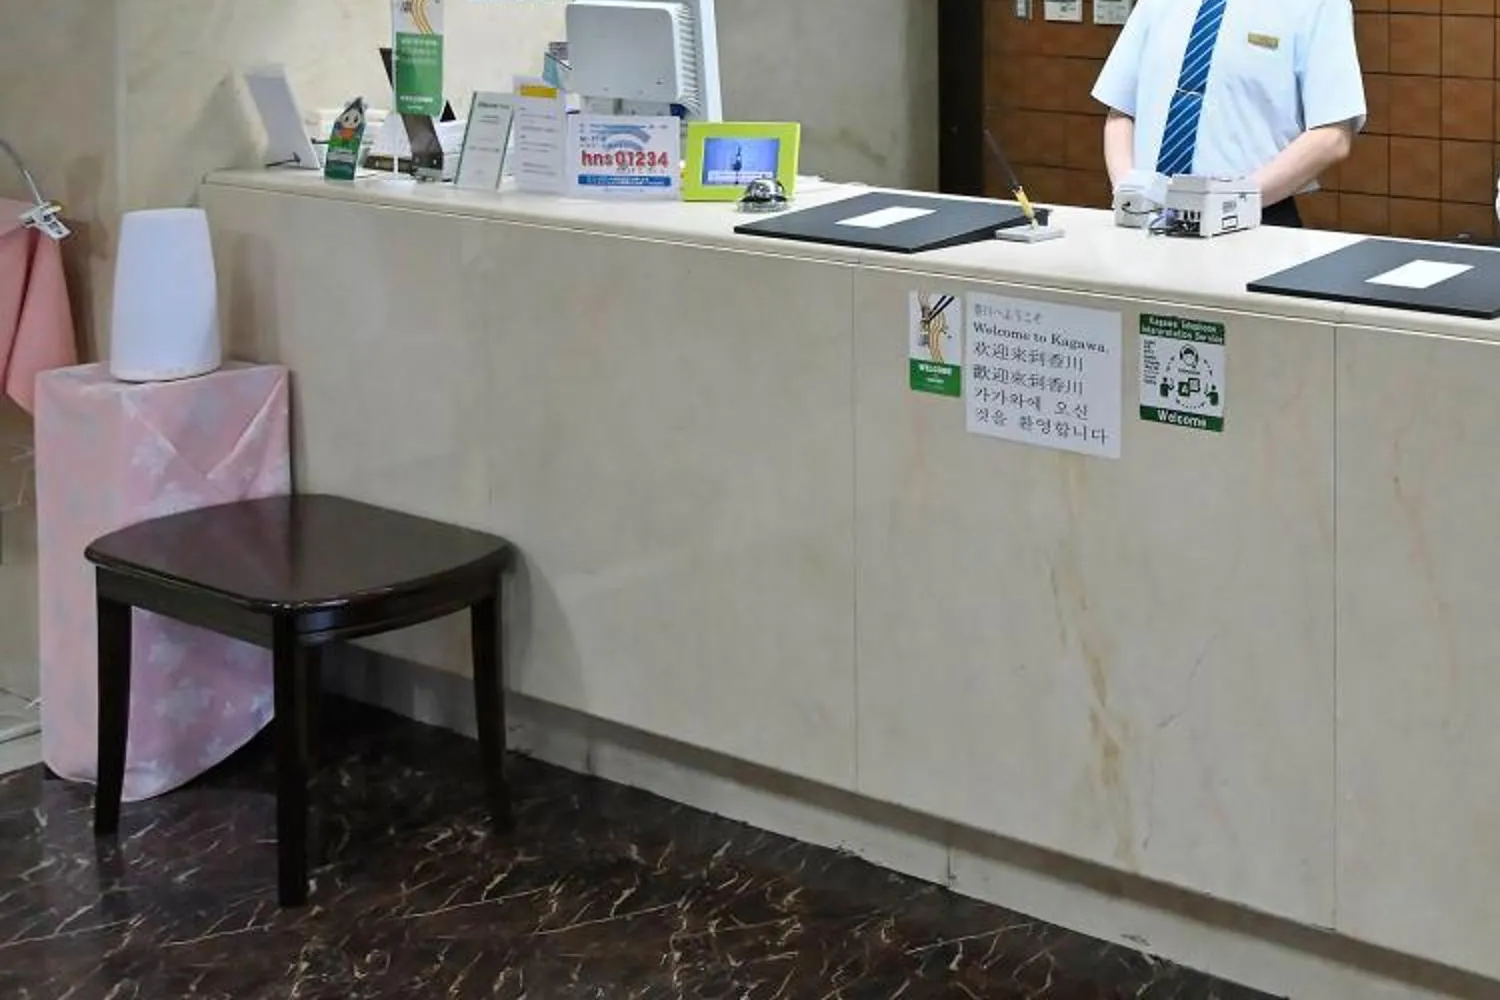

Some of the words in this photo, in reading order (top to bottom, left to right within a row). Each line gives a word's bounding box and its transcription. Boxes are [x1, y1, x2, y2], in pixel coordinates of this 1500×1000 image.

[973, 321, 1030, 340] Welcome
[1033, 333, 1047, 344] to
[1054, 401, 1088, 421] 오신
[1156, 408, 1207, 429] Welcome
[1019, 415, 1109, 446] 환영합니다
